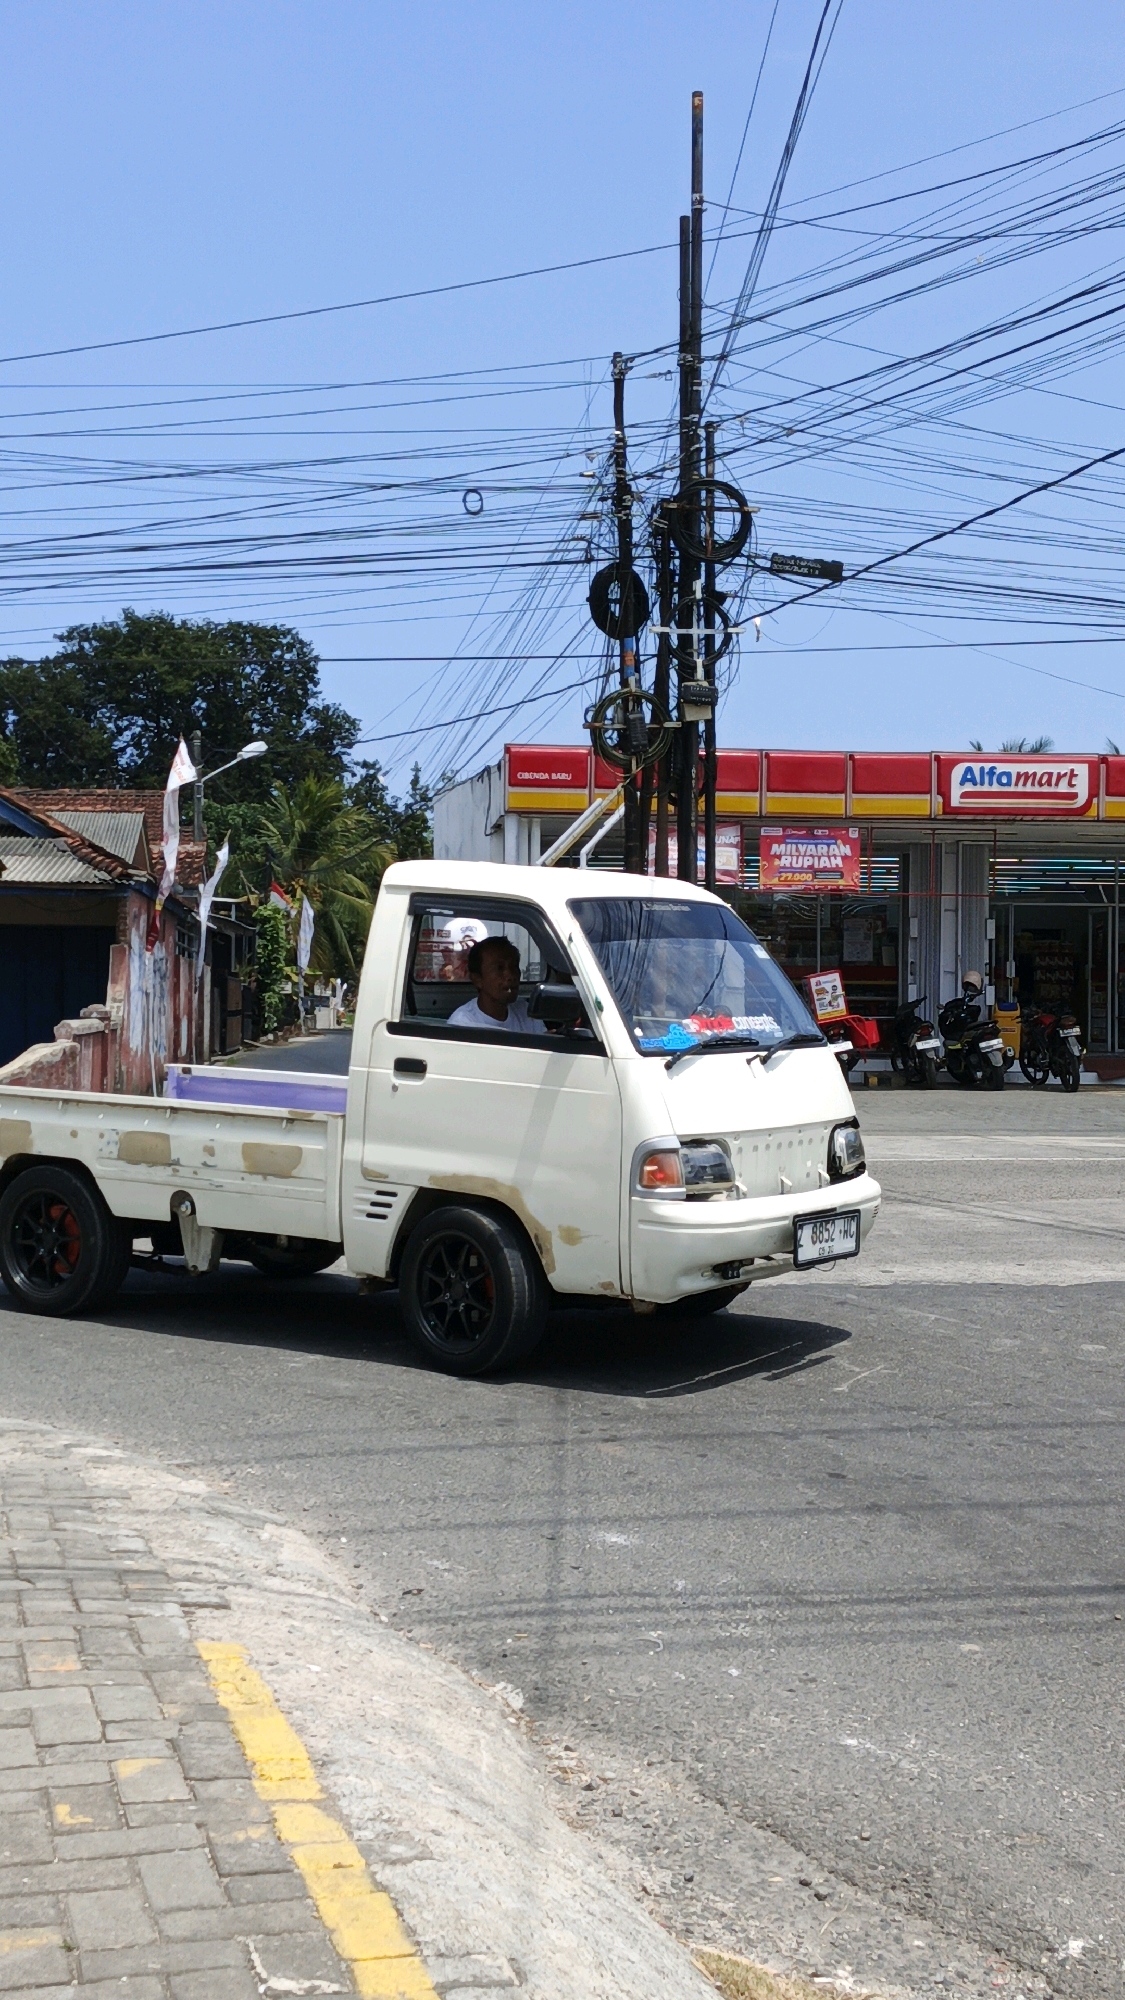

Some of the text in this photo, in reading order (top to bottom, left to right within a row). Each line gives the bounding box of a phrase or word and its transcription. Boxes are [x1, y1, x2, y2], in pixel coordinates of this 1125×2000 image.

[551, 772, 572, 781] BARU
[959, 765, 1079, 788] Alfamart
[769, 843, 852, 857] MILYARAN
[780, 855, 844, 869] RUPIAH
[780, 872, 813, 881] 27.000
[811, 1219, 836, 1246] 8852
